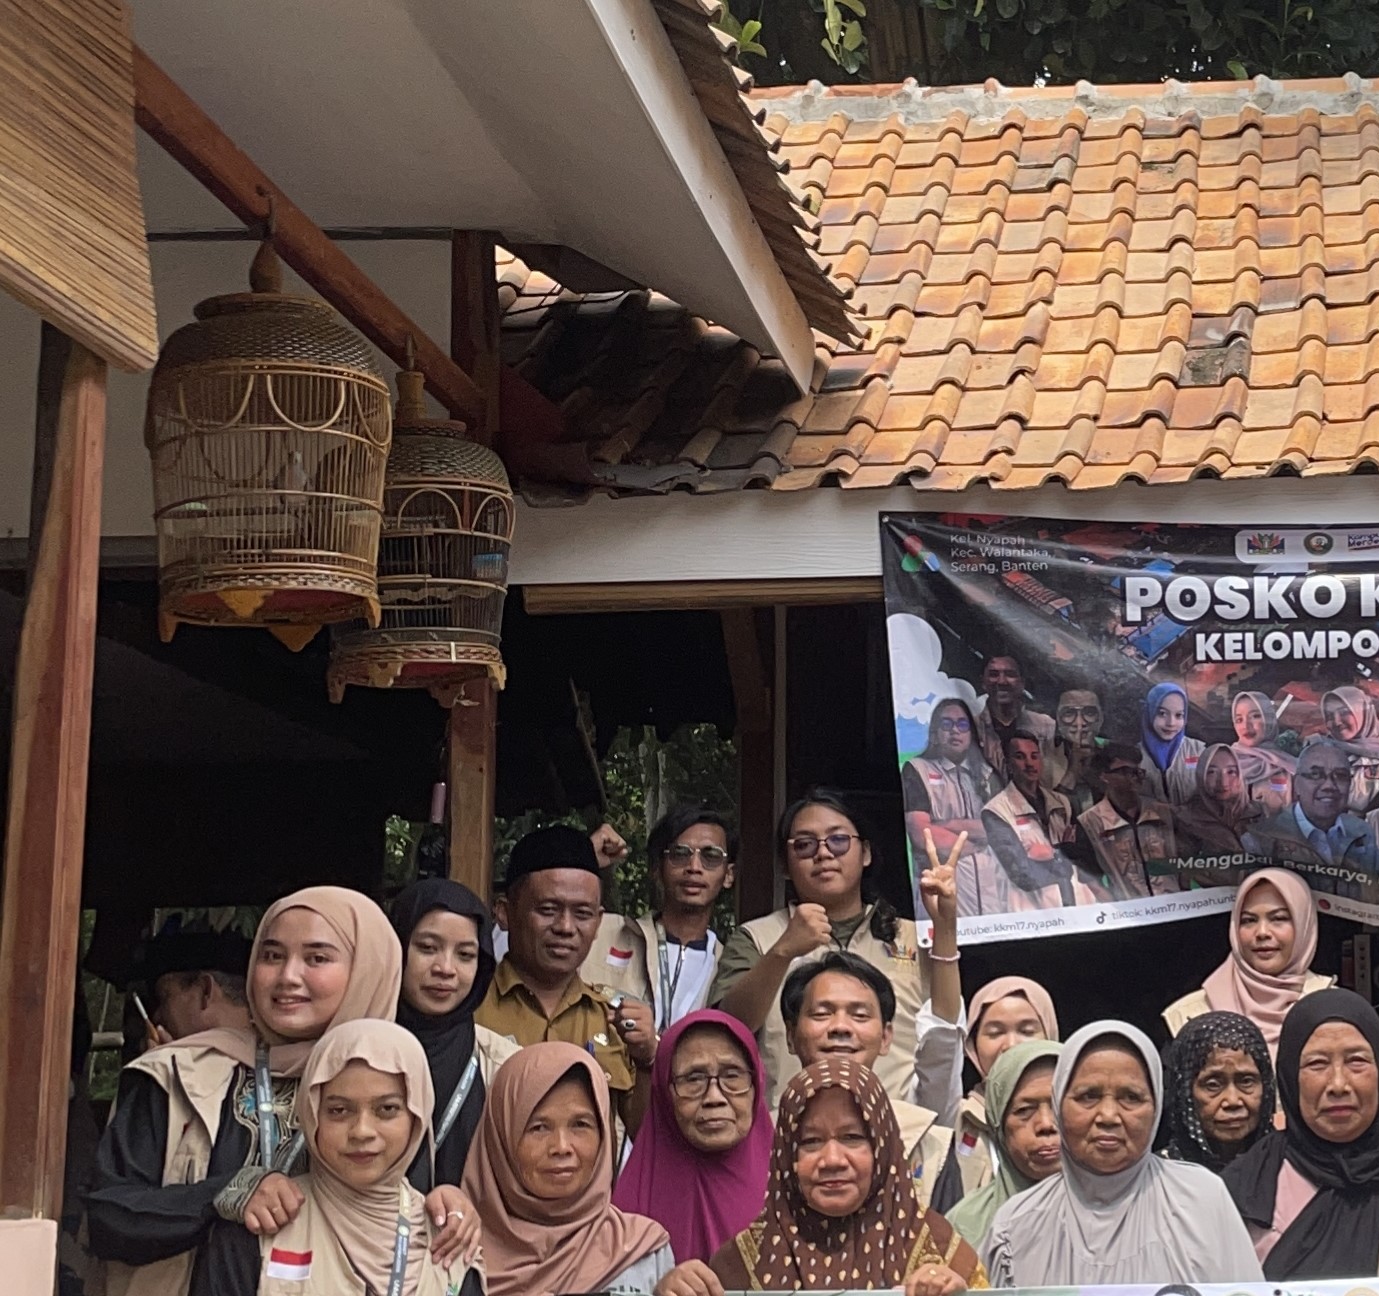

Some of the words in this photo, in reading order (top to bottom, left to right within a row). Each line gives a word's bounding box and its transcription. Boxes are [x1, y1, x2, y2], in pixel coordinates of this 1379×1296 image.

[976, 535, 1026, 546] Nyapah
[979, 547, 1052, 558] Walantaka,
[950, 561, 999, 574] Serang,
[1001, 560, 1049, 571] Banten
[1125, 575, 1346, 622] POSKO
[1145, 894, 1238, 915] kkm17.nyapah.unb
